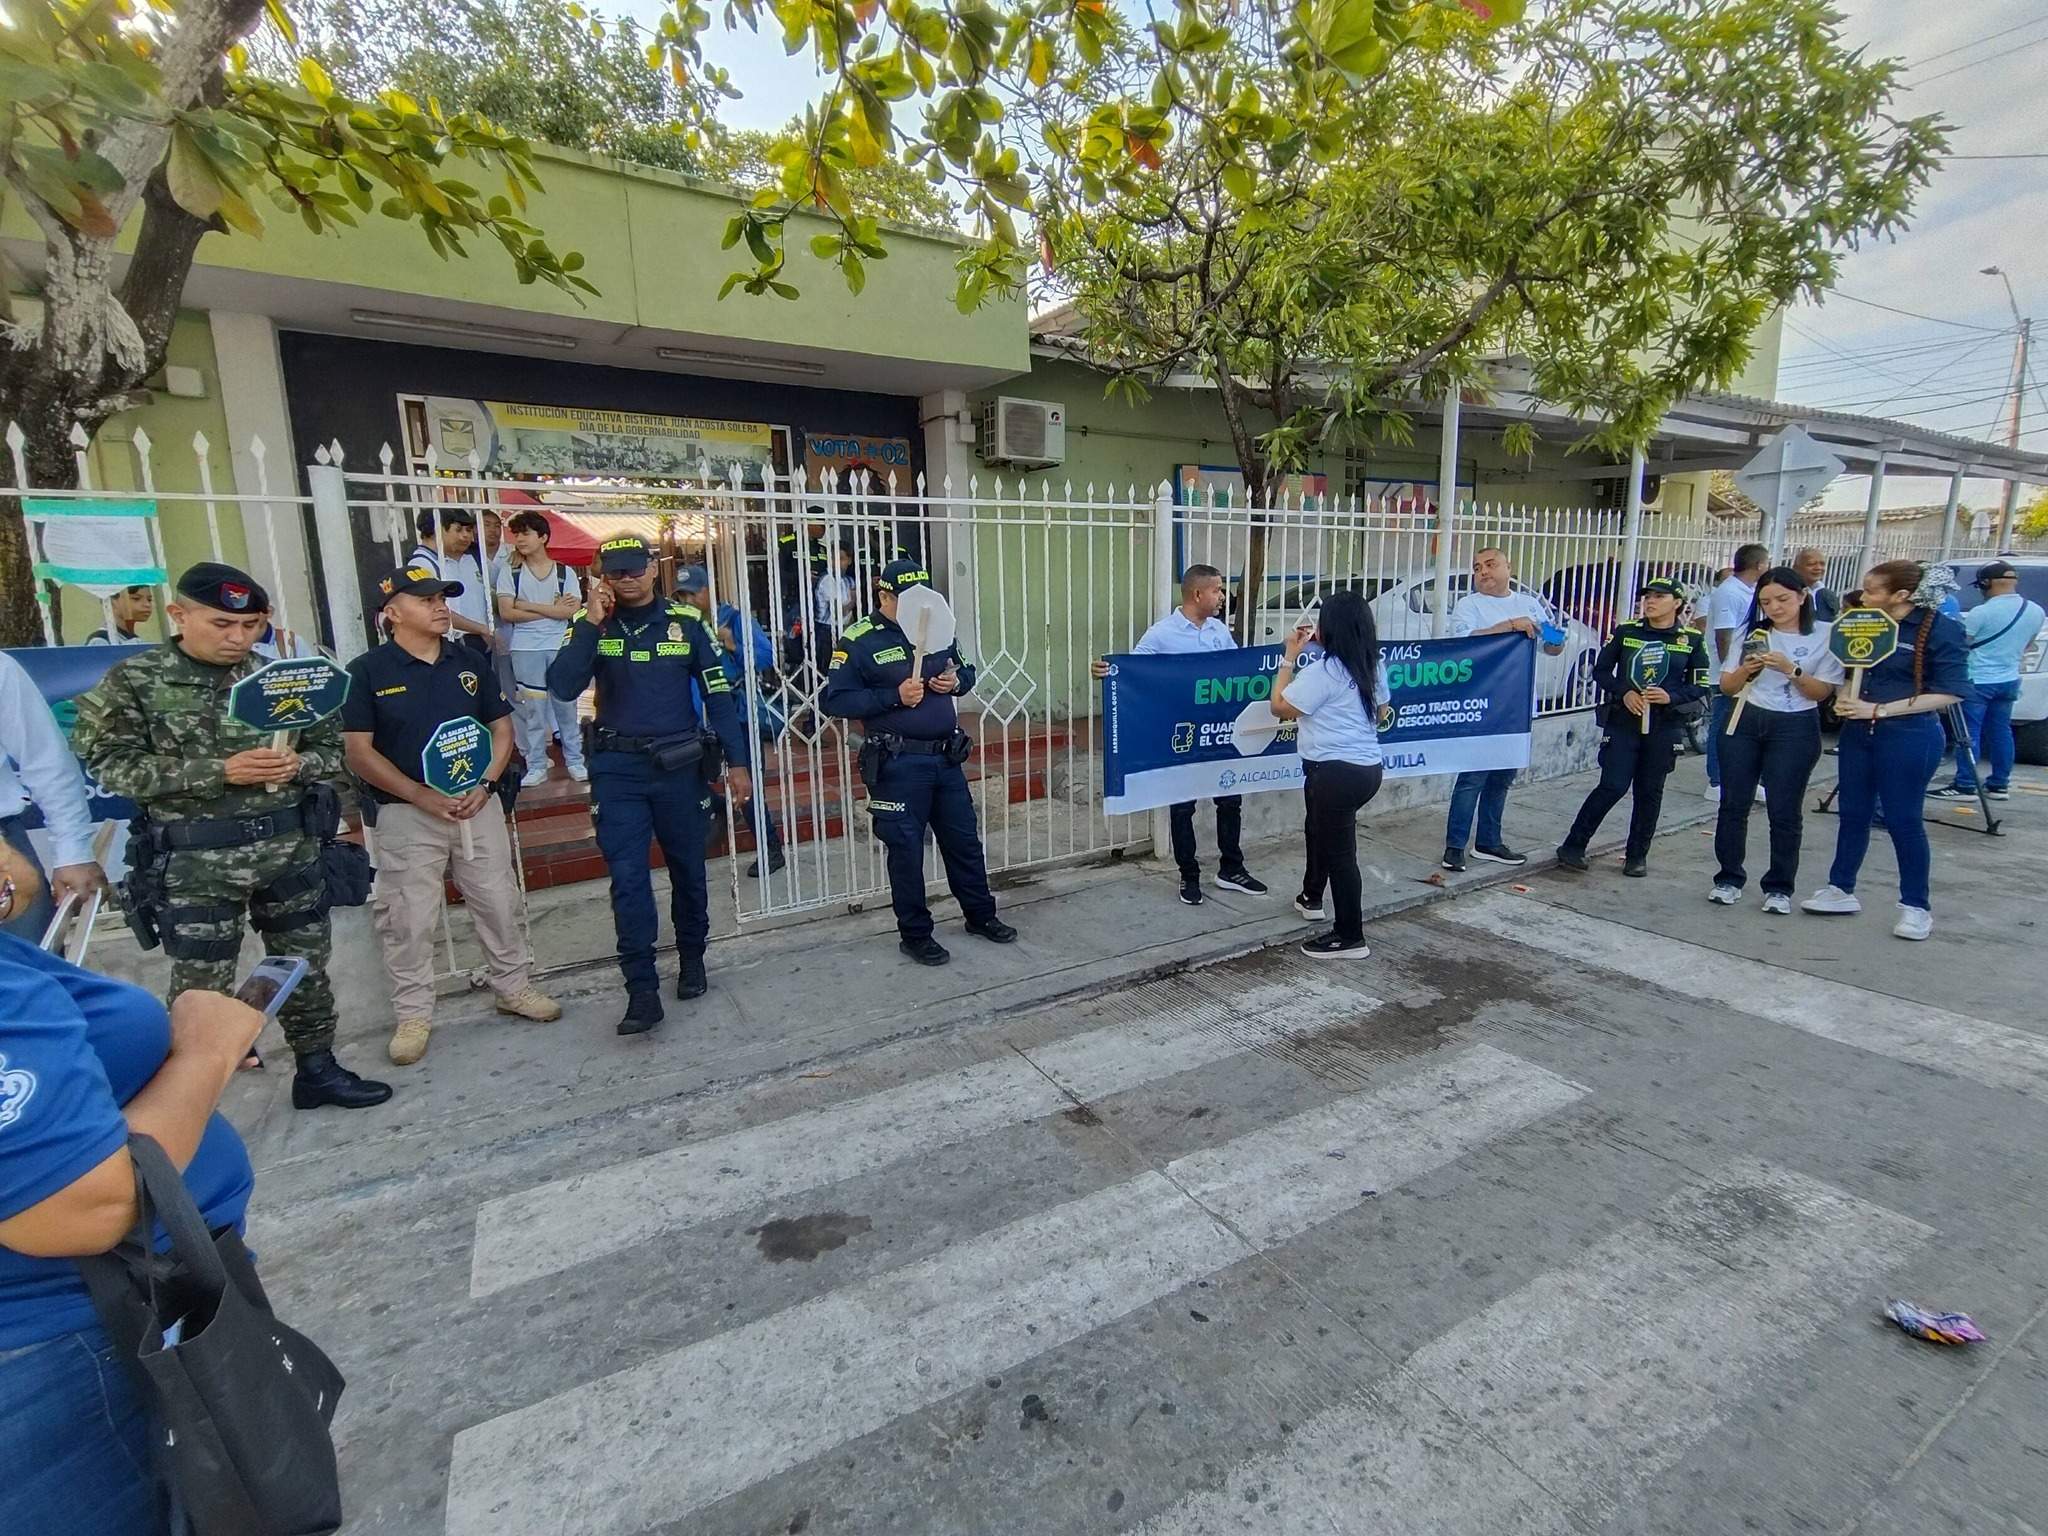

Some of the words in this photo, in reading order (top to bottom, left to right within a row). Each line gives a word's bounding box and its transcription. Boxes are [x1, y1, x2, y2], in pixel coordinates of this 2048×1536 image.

[506, 405, 568, 419] INSTITUCIÓN
[570, 409, 622, 423] EDUCATIVA
[624, 414, 668, 427] DISTRITAL
[671, 417, 692, 428] JUAN
[694, 419, 726, 431] ACOSTA
[727, 422, 758, 434] SOLERA
[597, 423, 609, 433] DE
[611, 424, 623, 434] LA
[625, 425, 701, 440] GOBERNABILIDAD
[809, 438, 860, 458] VOTA
[600, 537, 643, 553] POLICÍA
[1390, 643, 1421, 661] MÁS
[258, 676, 296, 684] CLASES
[309, 671, 335, 679] PARA
[280, 667, 315, 676] SALIDA
[316, 665, 330, 673] DE
[1195, 674, 1278, 705] ENTO
[1387, 658, 1473, 690] GUROS
[263, 688, 290, 696] PARA
[291, 684, 325, 693] PELEAR
[1399, 703, 1427, 716] CERO
[1429, 700, 1461, 713] TRATO
[1463, 698, 1489, 710] CON
[1200, 721, 1236, 734] GUAR
[1397, 711, 1482, 728] DESCONOCIDOS
[447, 726, 468, 737] SALIDA
[465, 729, 480, 738] PARA
[1199, 735, 1213, 746] EL
[1239, 766, 1292, 783] ALCALDÍA
[1294, 767, 1302, 778] D
